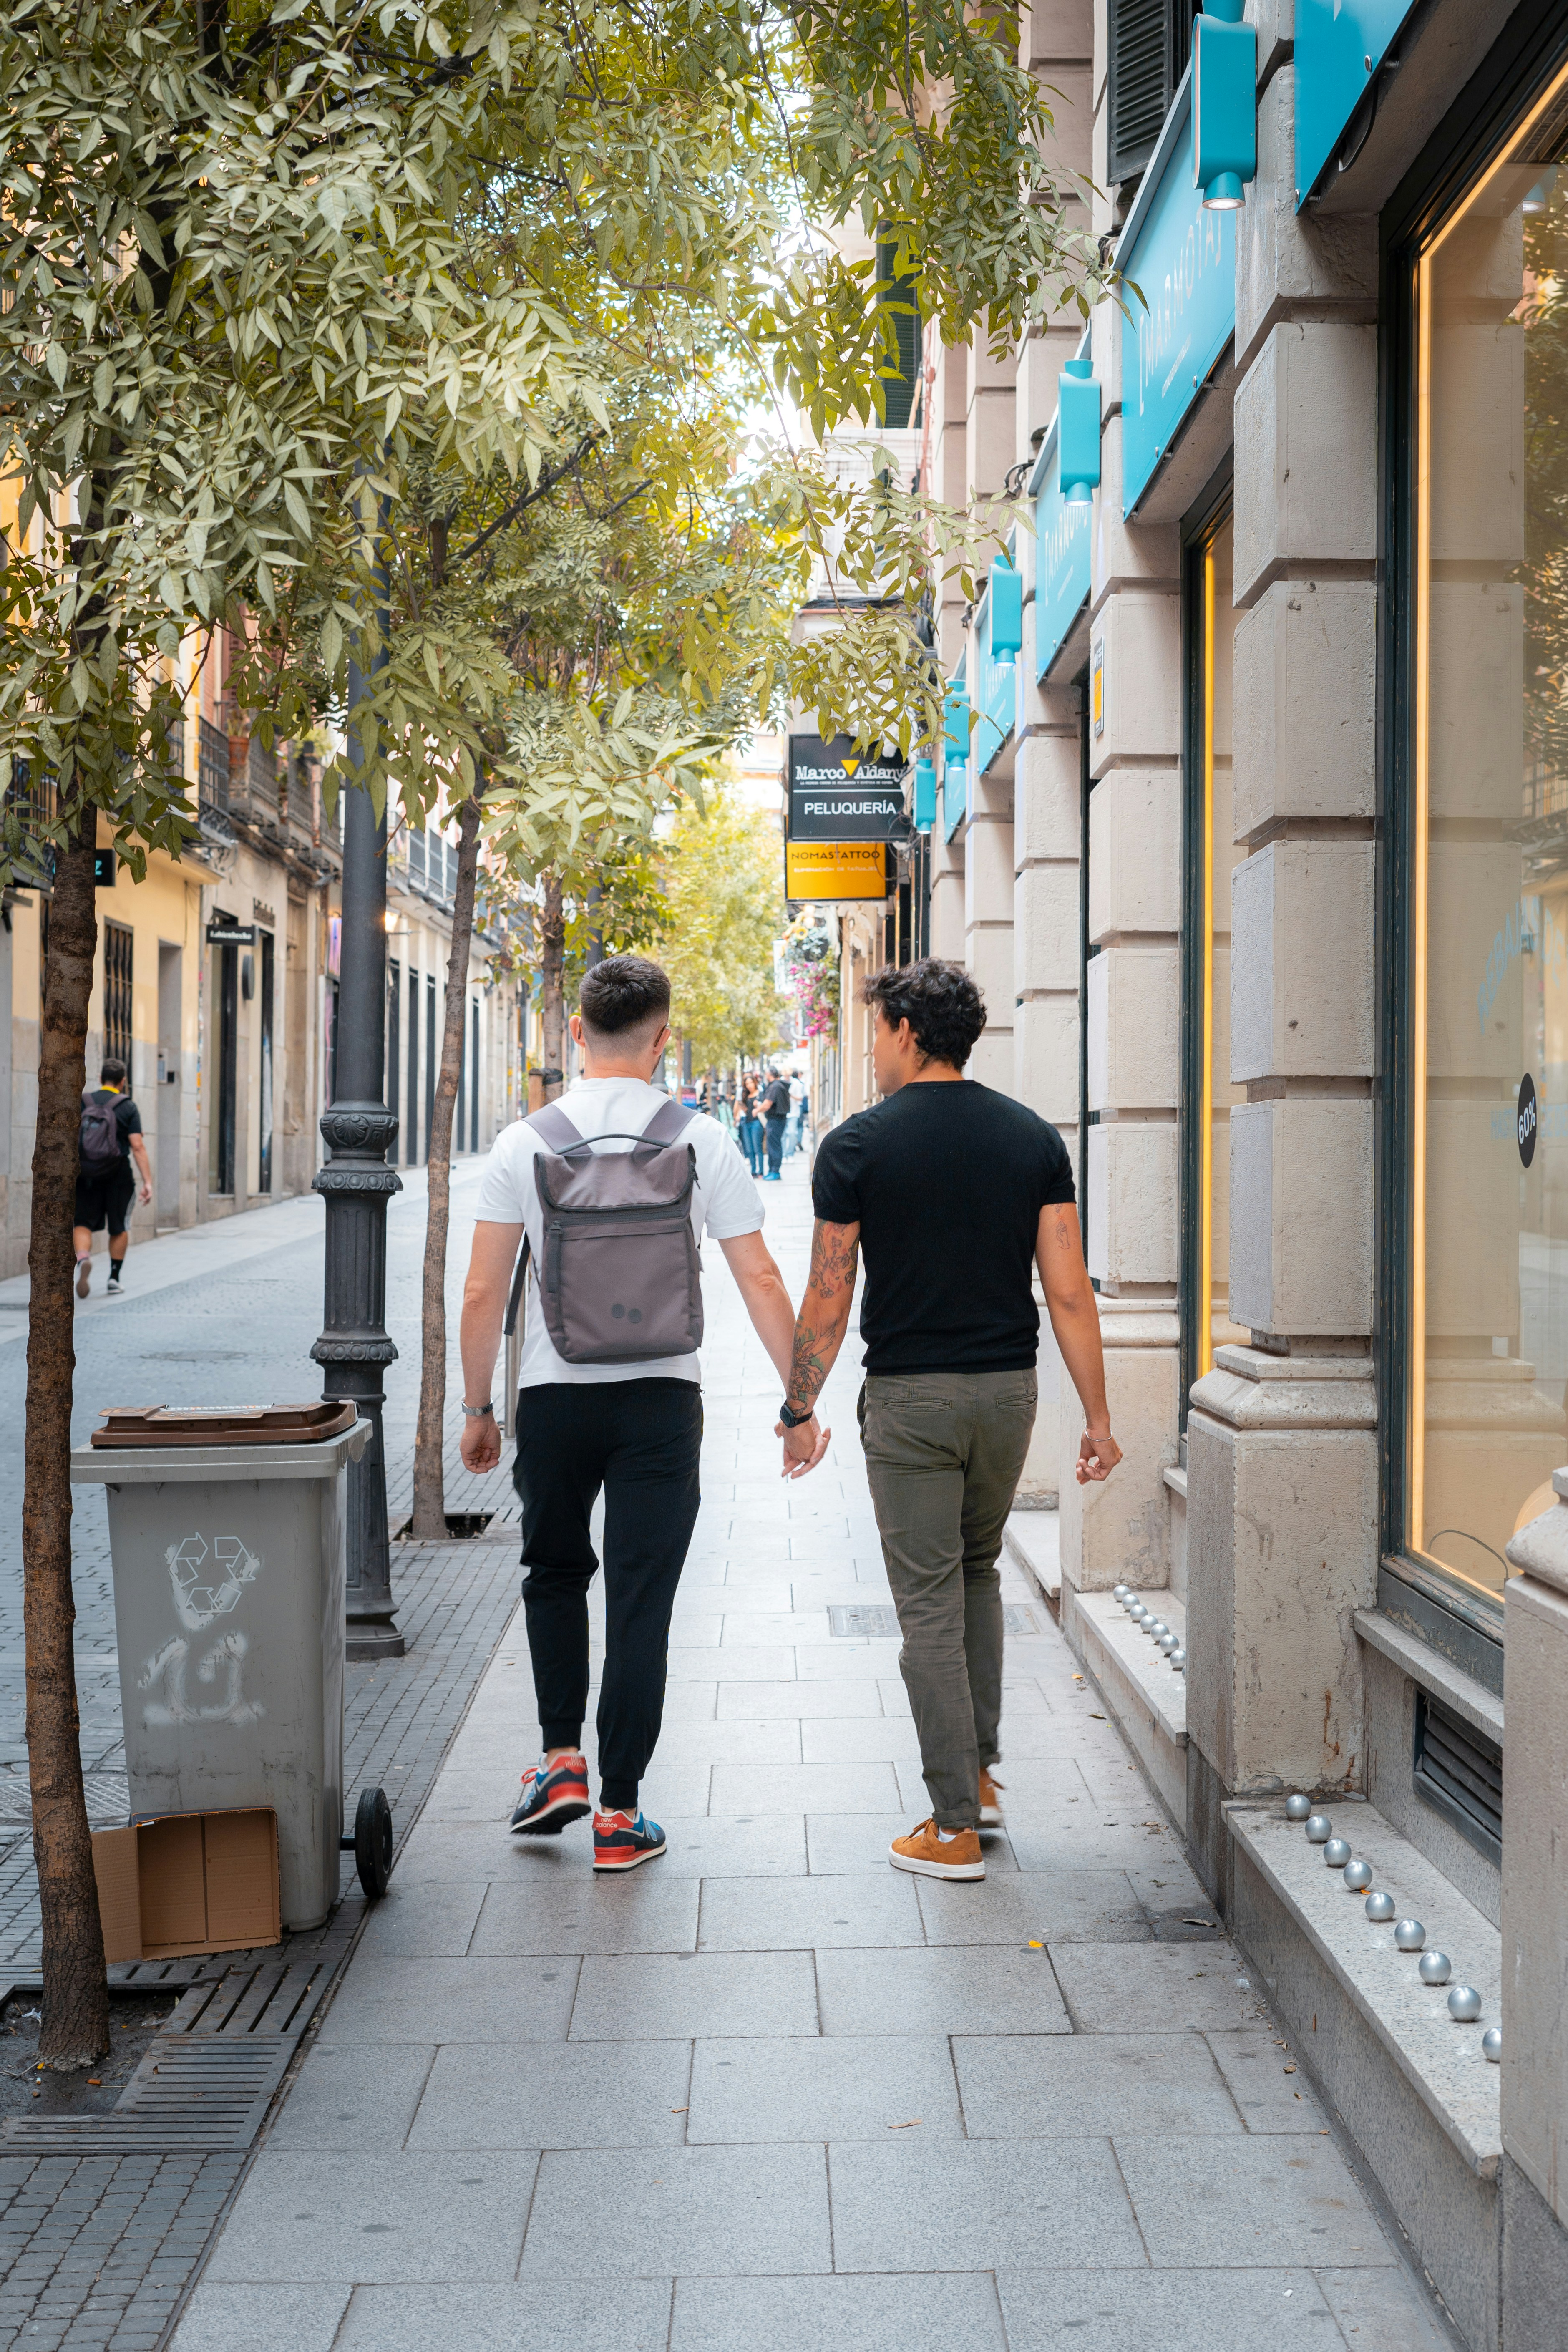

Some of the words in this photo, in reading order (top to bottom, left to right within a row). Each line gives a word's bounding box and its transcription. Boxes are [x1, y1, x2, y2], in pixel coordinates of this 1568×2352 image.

[795, 765, 846, 780] Marco
[853, 765, 903, 783] Aldany
[804, 799, 897, 815] PELUQUERÍA
[1518, 1096, 1536, 1145] 60%
